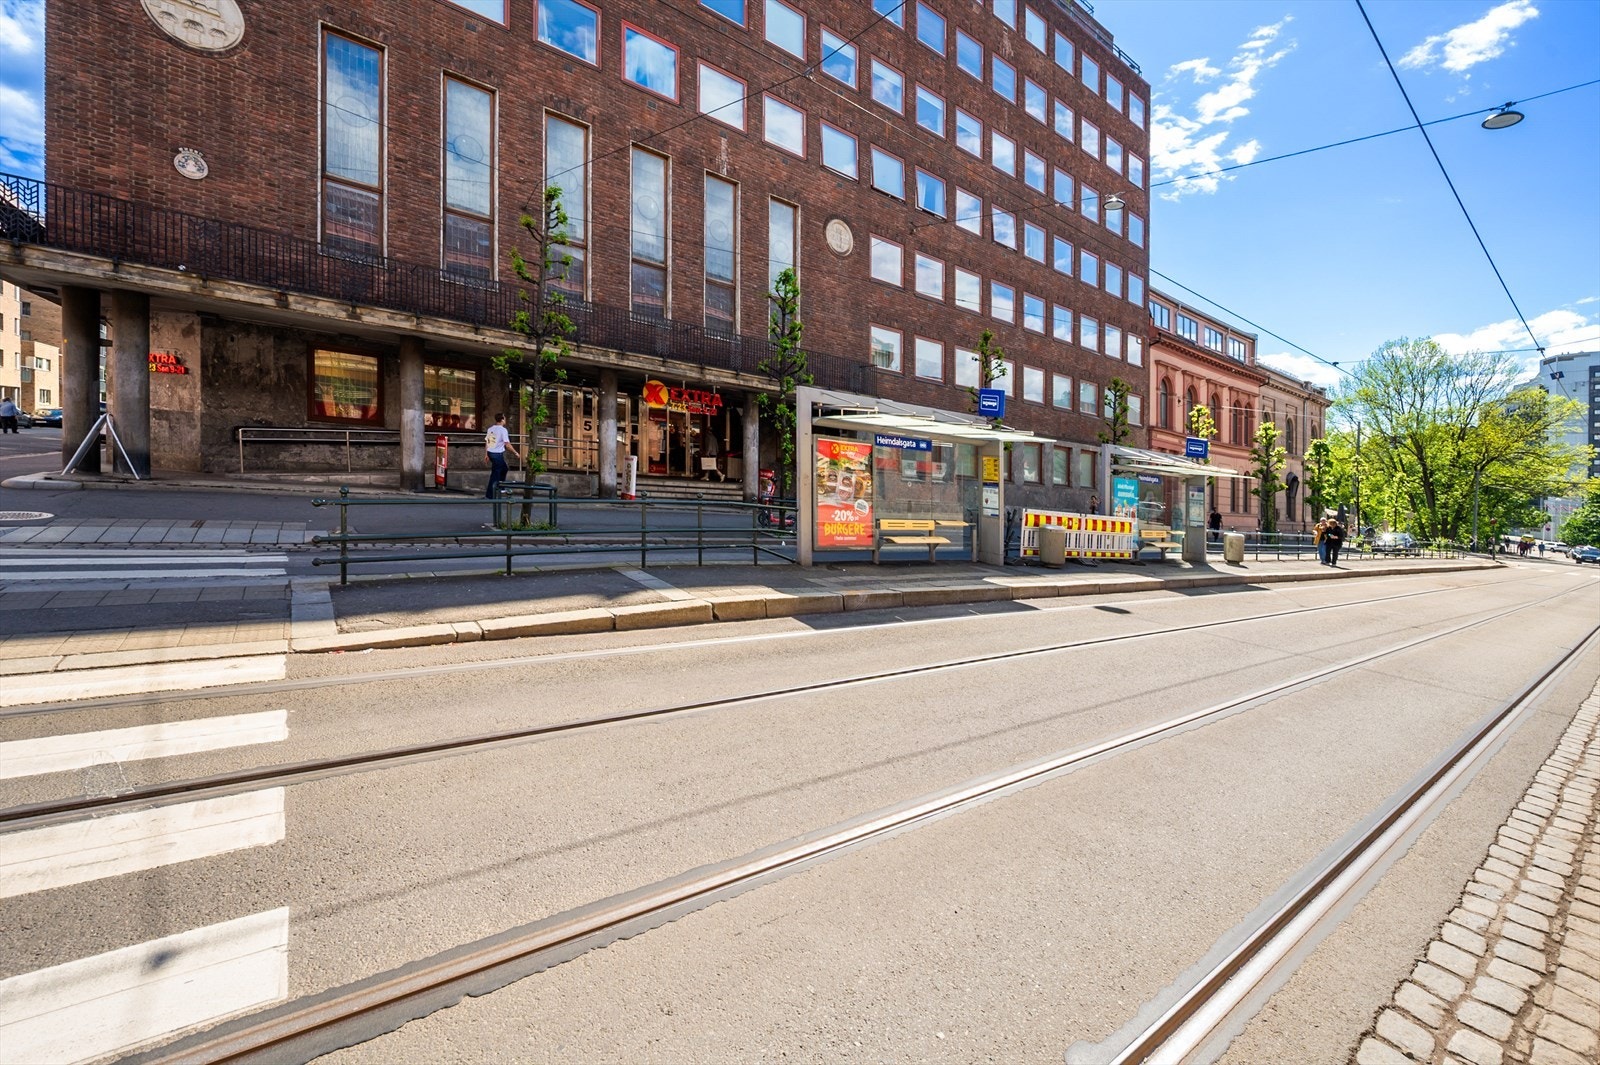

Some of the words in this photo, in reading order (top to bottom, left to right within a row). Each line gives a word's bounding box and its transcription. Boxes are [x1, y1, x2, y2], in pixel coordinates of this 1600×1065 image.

[149, 354, 176, 364] XTRA
[670, 388, 723, 407] EXTRA
[583, 420, 592, 432] 5
[877, 436, 916, 448] Heimdalsgata
[831, 509, 855, 522] -20%
[824, 522, 866, 537] BURGERE
